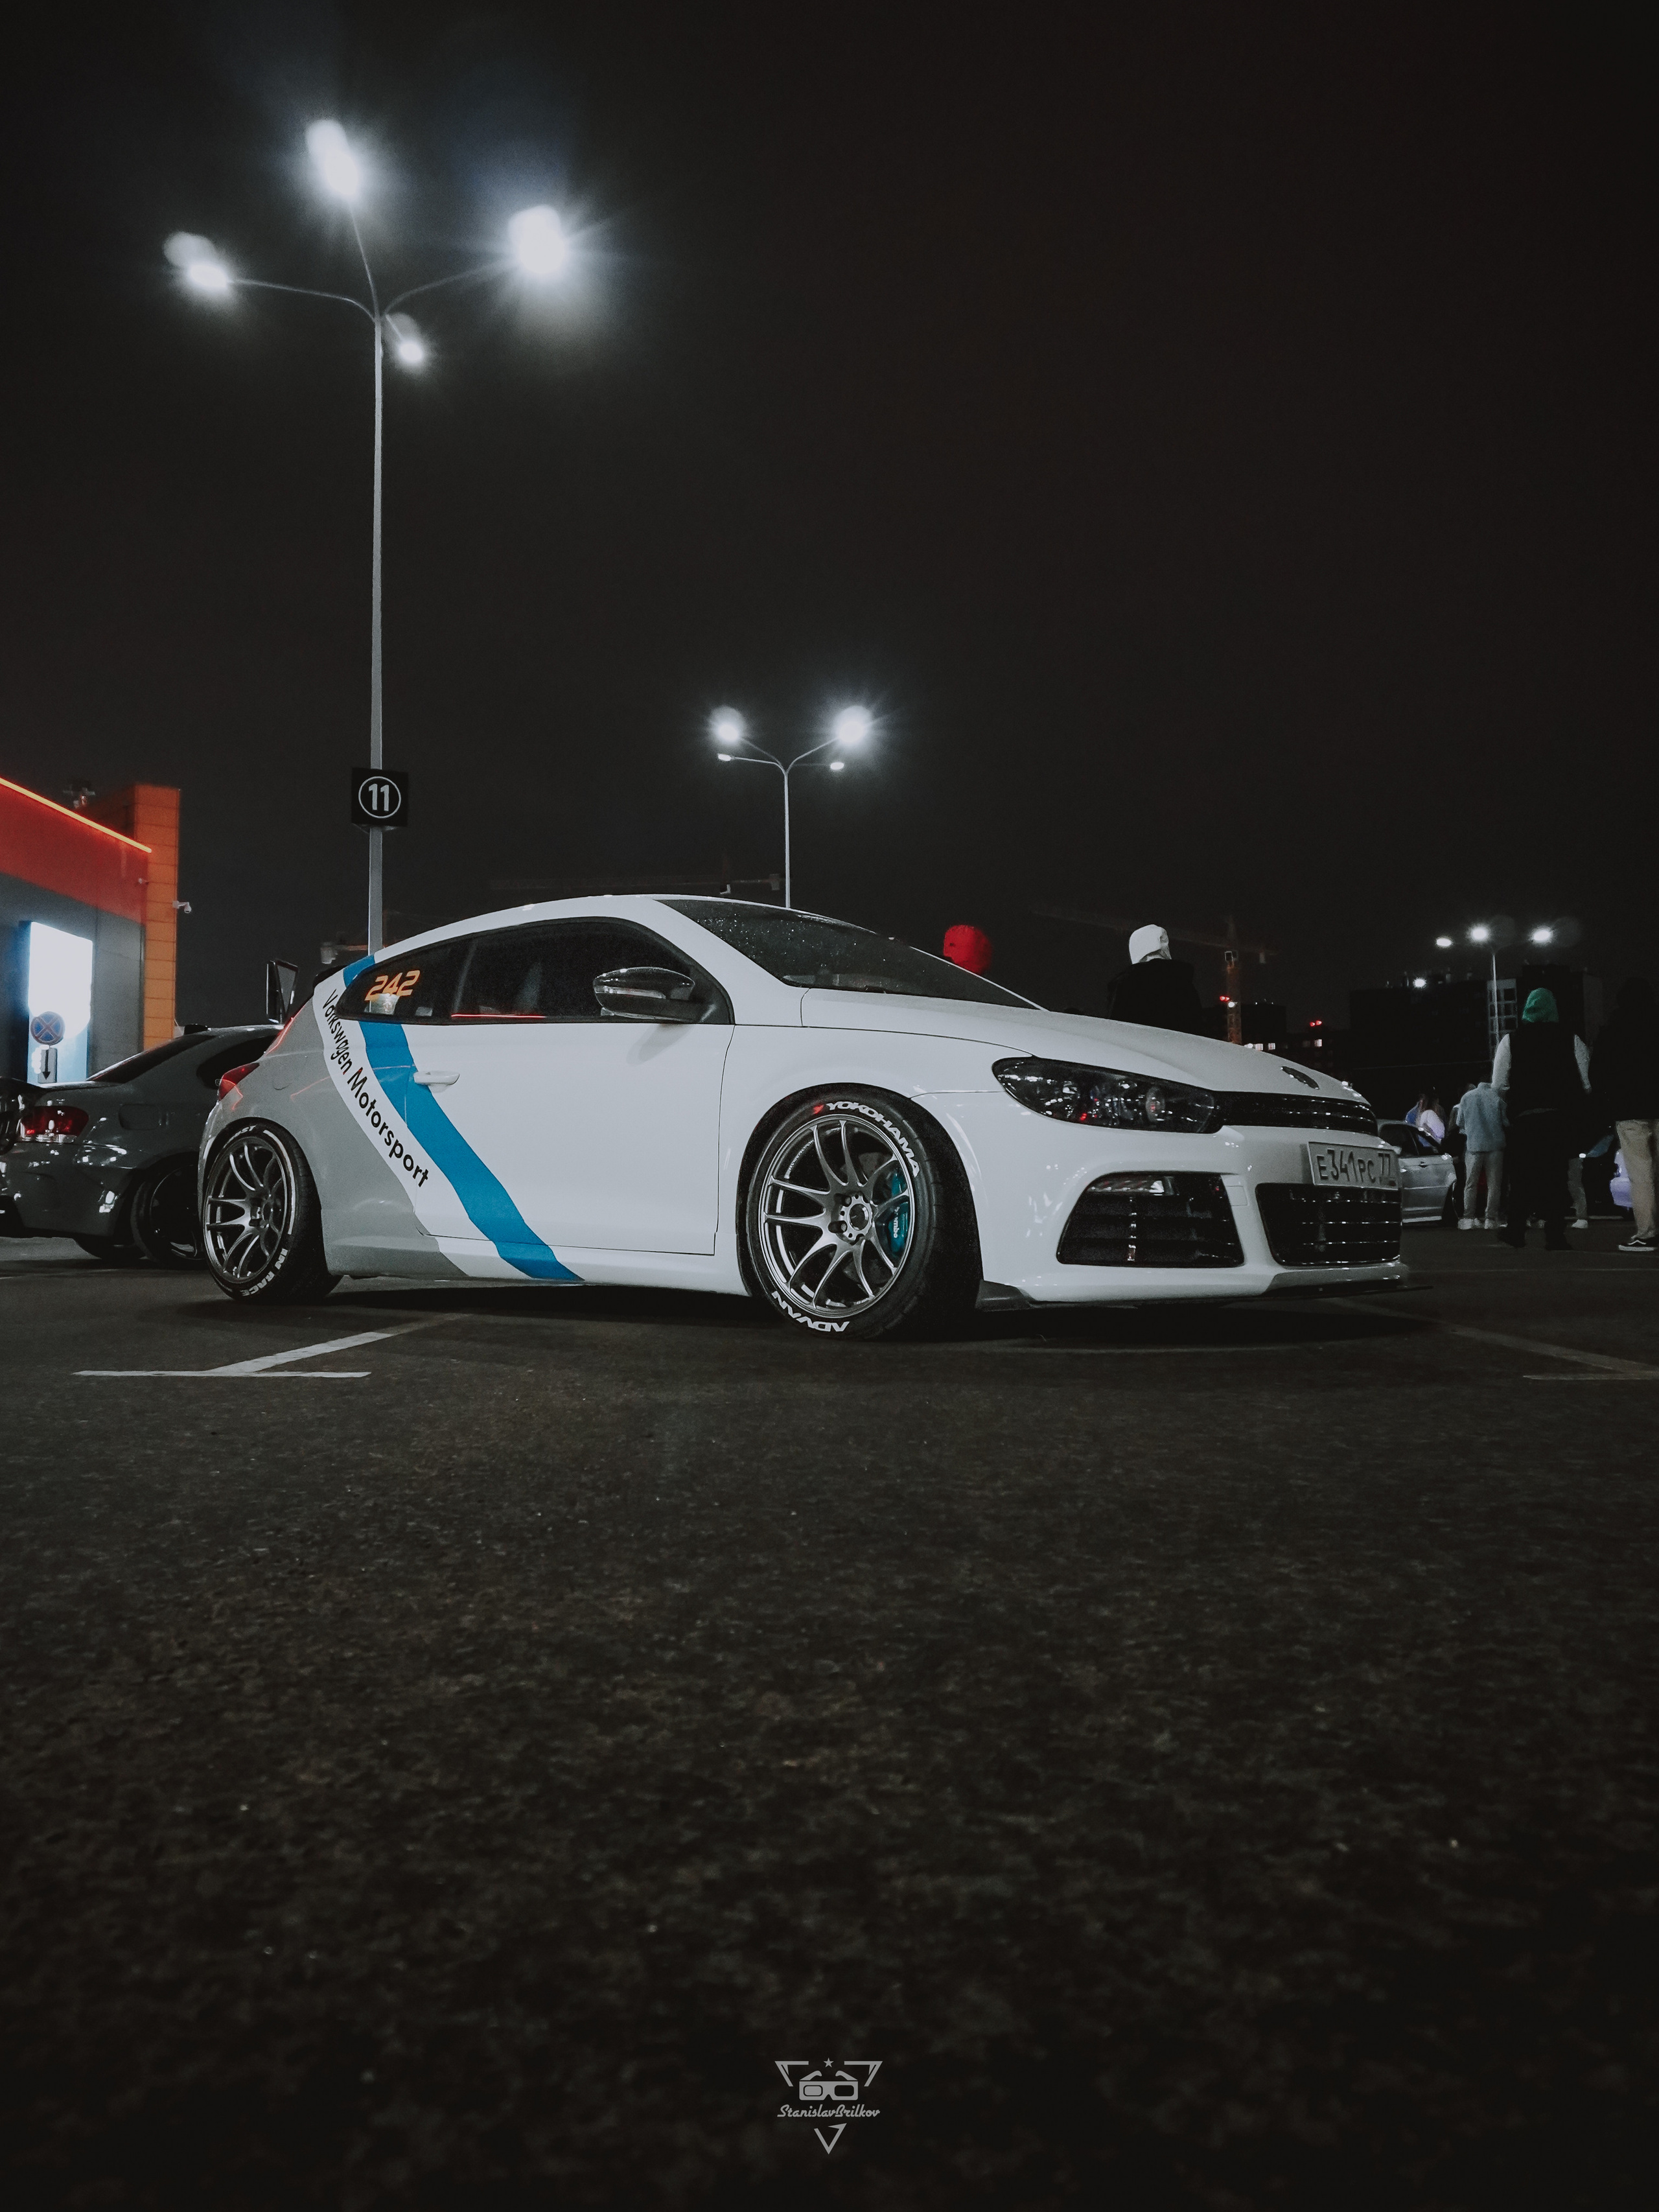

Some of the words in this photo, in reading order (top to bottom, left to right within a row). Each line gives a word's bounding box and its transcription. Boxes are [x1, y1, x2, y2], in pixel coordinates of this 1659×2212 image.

[369, 784, 389, 811] 11
[364, 970, 420, 1001] 242
[347, 1067, 428, 1187] Motorsport
[826, 1101, 920, 1178] YOKOHAMA
[771, 1290, 850, 1332] ADVAN
